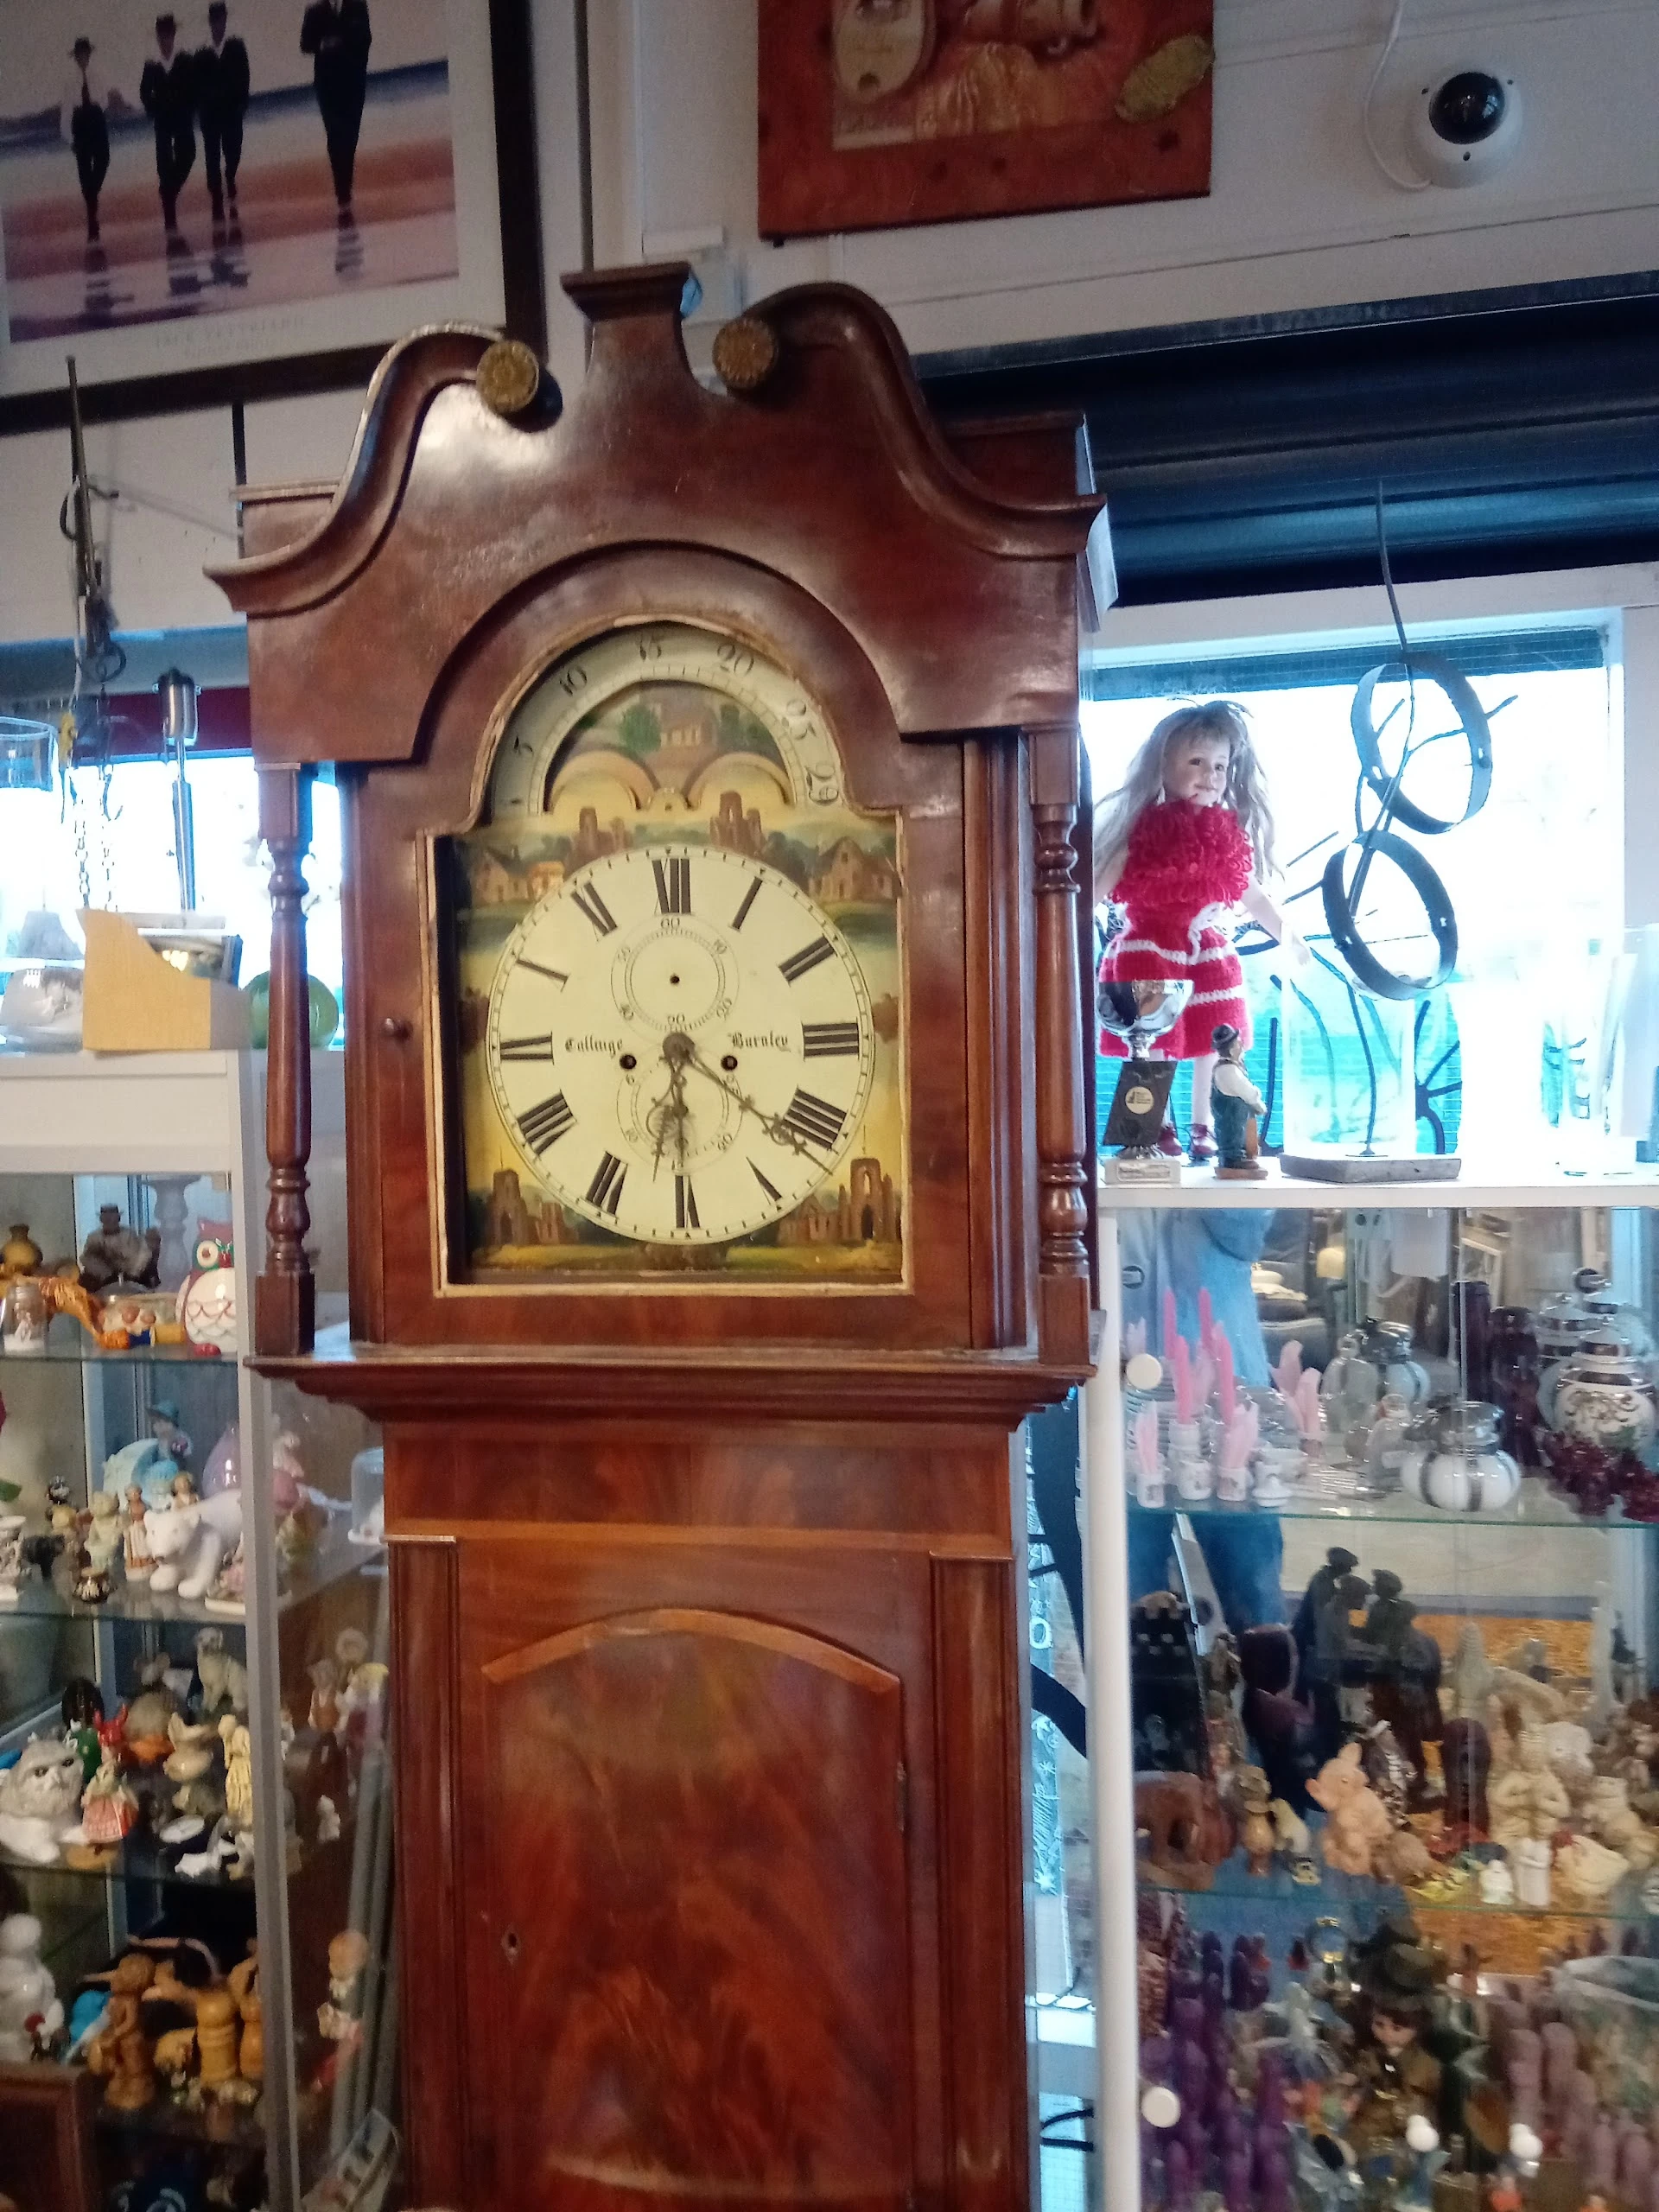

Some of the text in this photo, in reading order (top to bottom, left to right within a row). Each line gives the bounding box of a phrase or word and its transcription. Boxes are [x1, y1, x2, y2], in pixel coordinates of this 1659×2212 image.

[559, 666, 588, 696] 10
[716, 644, 754, 677] 20
[570, 881, 618, 942] XI
[652, 857, 693, 916] XII
[728, 875, 763, 932] I
[660, 917, 681, 931] 60
[777, 933, 837, 987] II
[728, 1030, 791, 1052] Burnley
[801, 1017, 860, 1062] III
[517, 1089, 577, 1161] VIII
[585, 1150, 629, 1217] VII
[674, 1174, 702, 1230] VI
[746, 1155, 784, 1207] V
